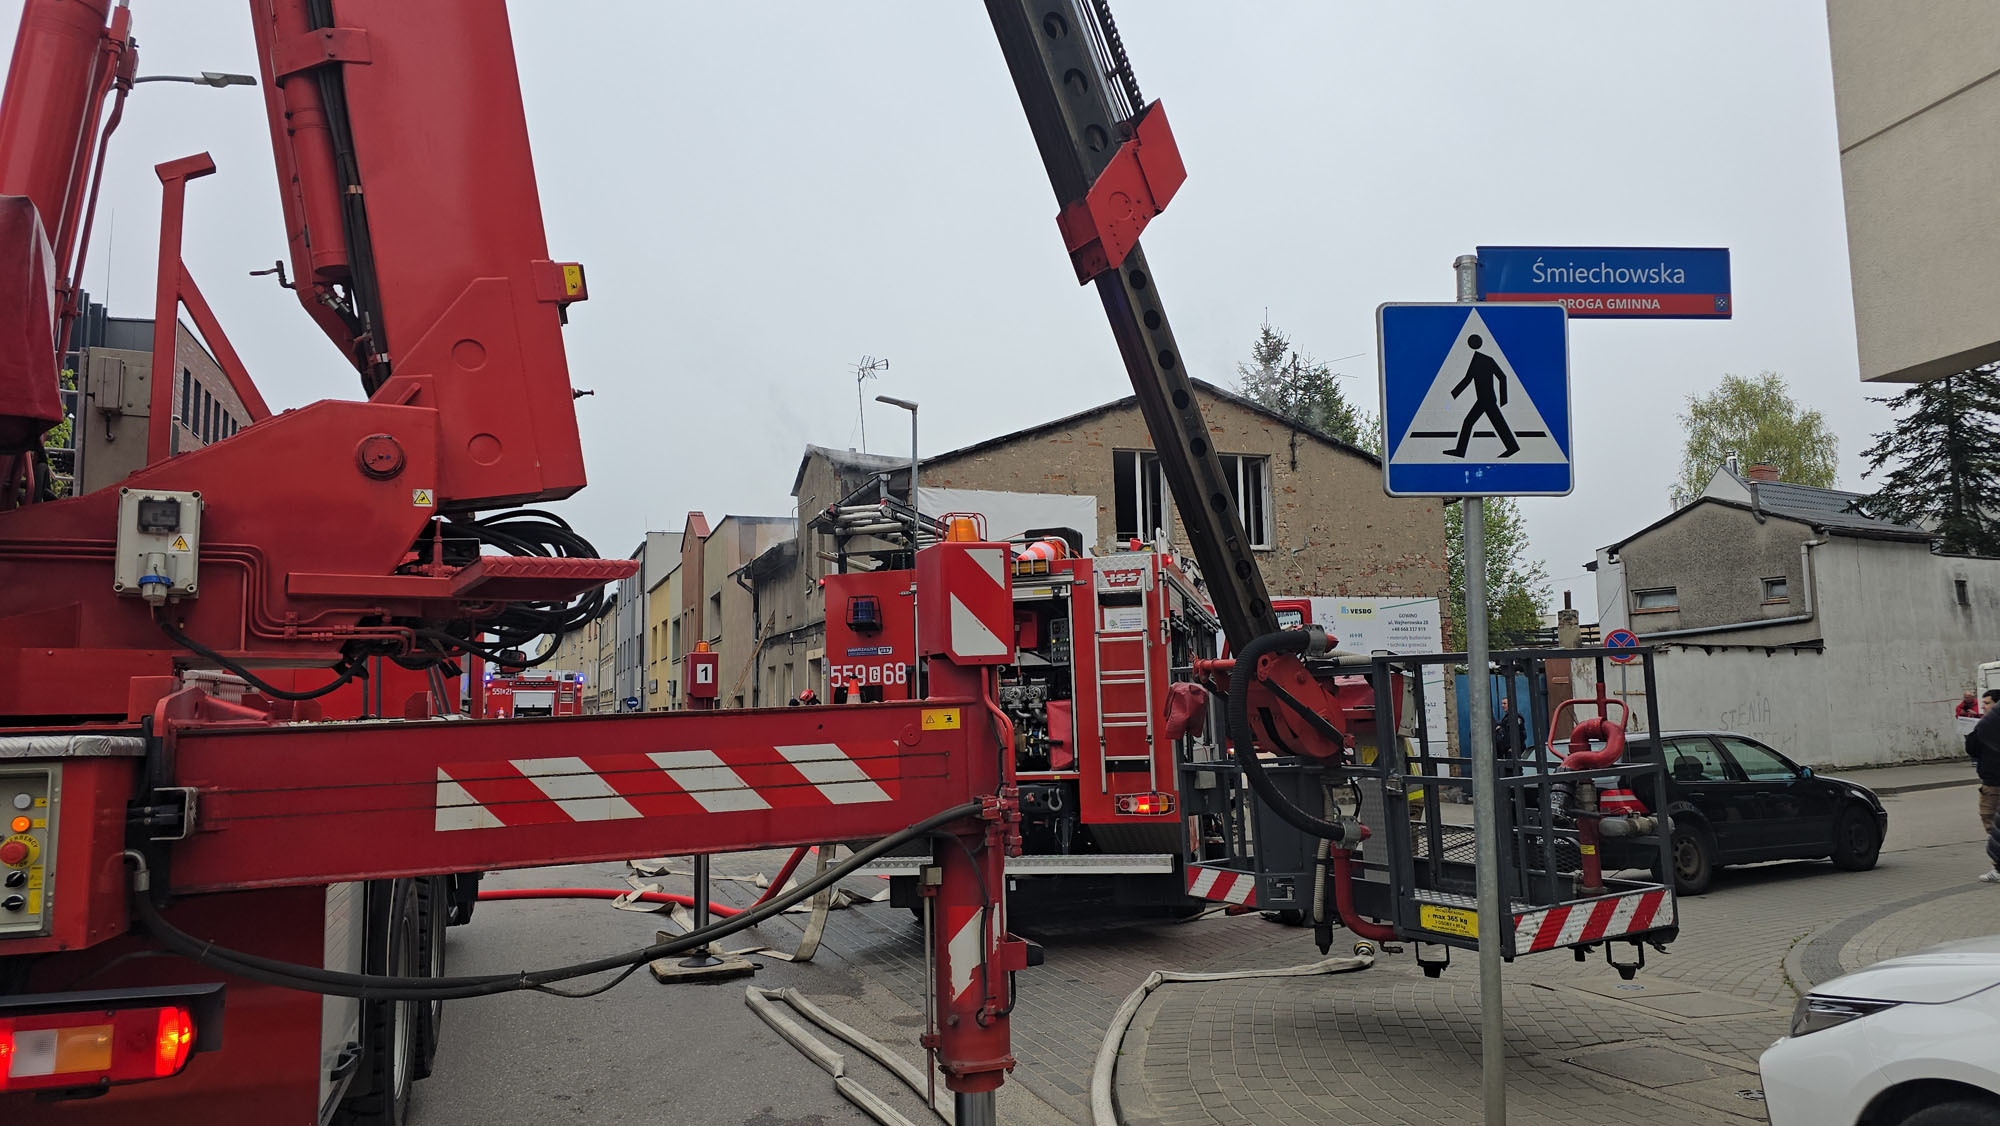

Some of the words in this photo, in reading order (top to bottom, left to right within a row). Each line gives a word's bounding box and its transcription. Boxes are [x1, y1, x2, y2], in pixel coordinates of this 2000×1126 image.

[1532, 257, 1686, 284] Śmiechowska
[1606, 298, 1661, 310] GMINNA
[701, 666, 708, 681] 1
